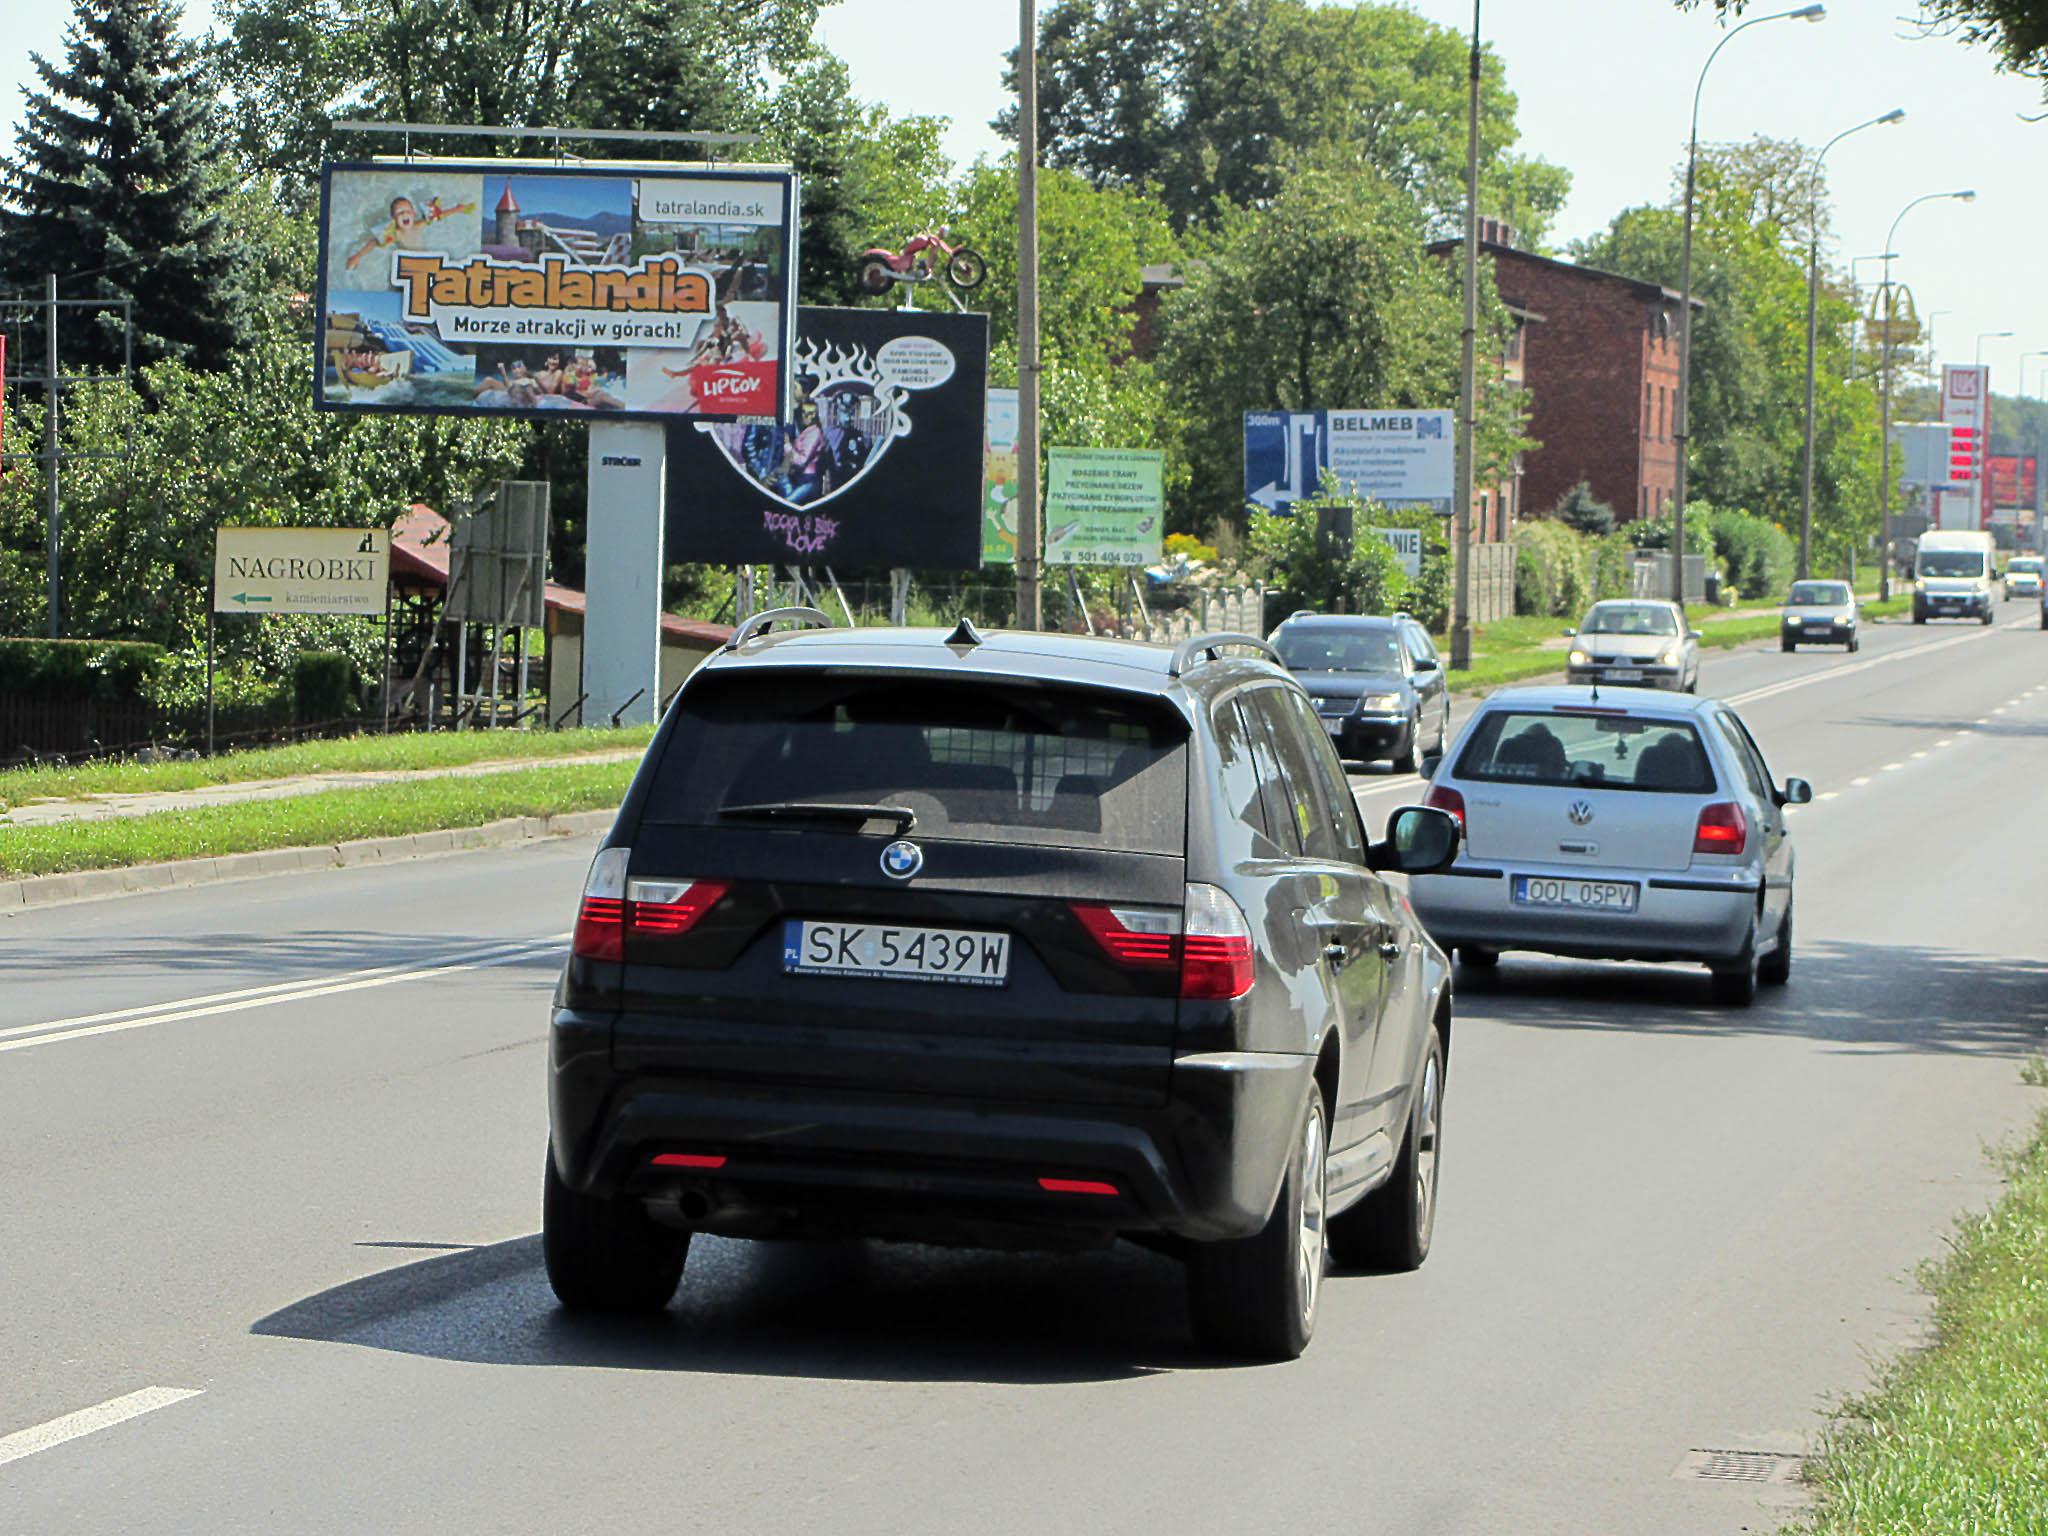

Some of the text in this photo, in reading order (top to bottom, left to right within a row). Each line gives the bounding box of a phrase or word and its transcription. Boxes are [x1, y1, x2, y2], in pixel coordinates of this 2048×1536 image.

[656, 200, 765, 217] tatralandia.sk
[397, 254, 710, 317] Tatralandia
[454, 316, 682, 341] Morze atrakcji w górach!
[1332, 416, 1413, 431] BELMEB
[786, 535, 828, 553] LOVE
[1078, 551, 1097, 562] 501
[1100, 552, 1121, 562] 404
[229, 557, 376, 581] NAGROBKI
[286, 591, 369, 604] kamieniarstwo
[1580, 884, 1631, 906] 05PV
[785, 927, 1003, 974] PL SK 5439W
